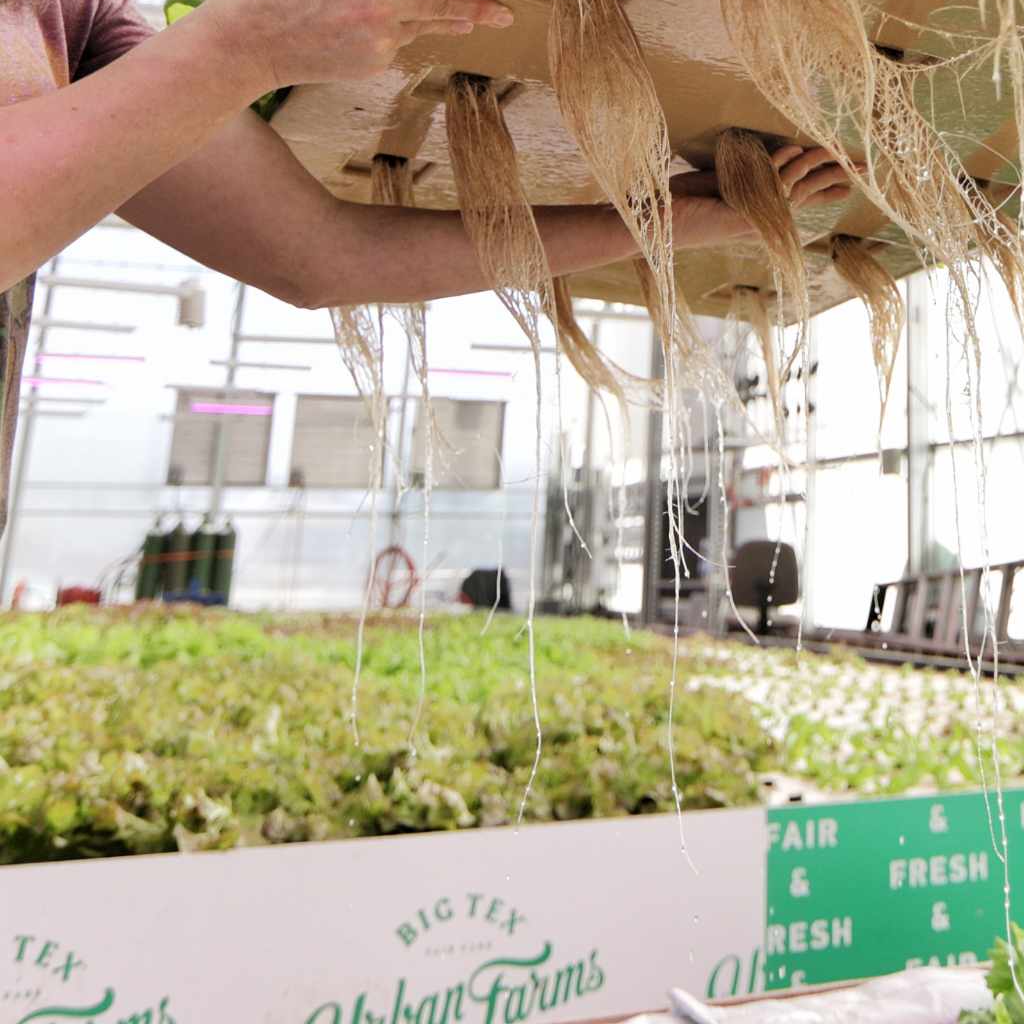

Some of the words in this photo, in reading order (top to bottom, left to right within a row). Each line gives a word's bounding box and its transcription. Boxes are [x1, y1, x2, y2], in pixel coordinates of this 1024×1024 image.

[768, 817, 839, 852] FAIR
[928, 804, 948, 833] &
[789, 867, 811, 897] &
[889, 852, 989, 890] FRESH
[396, 897, 454, 948] BIG
[466, 892, 528, 936] TEX
[931, 901, 950, 931] &
[768, 915, 854, 956] RESH
[14, 934, 85, 982] TEX
